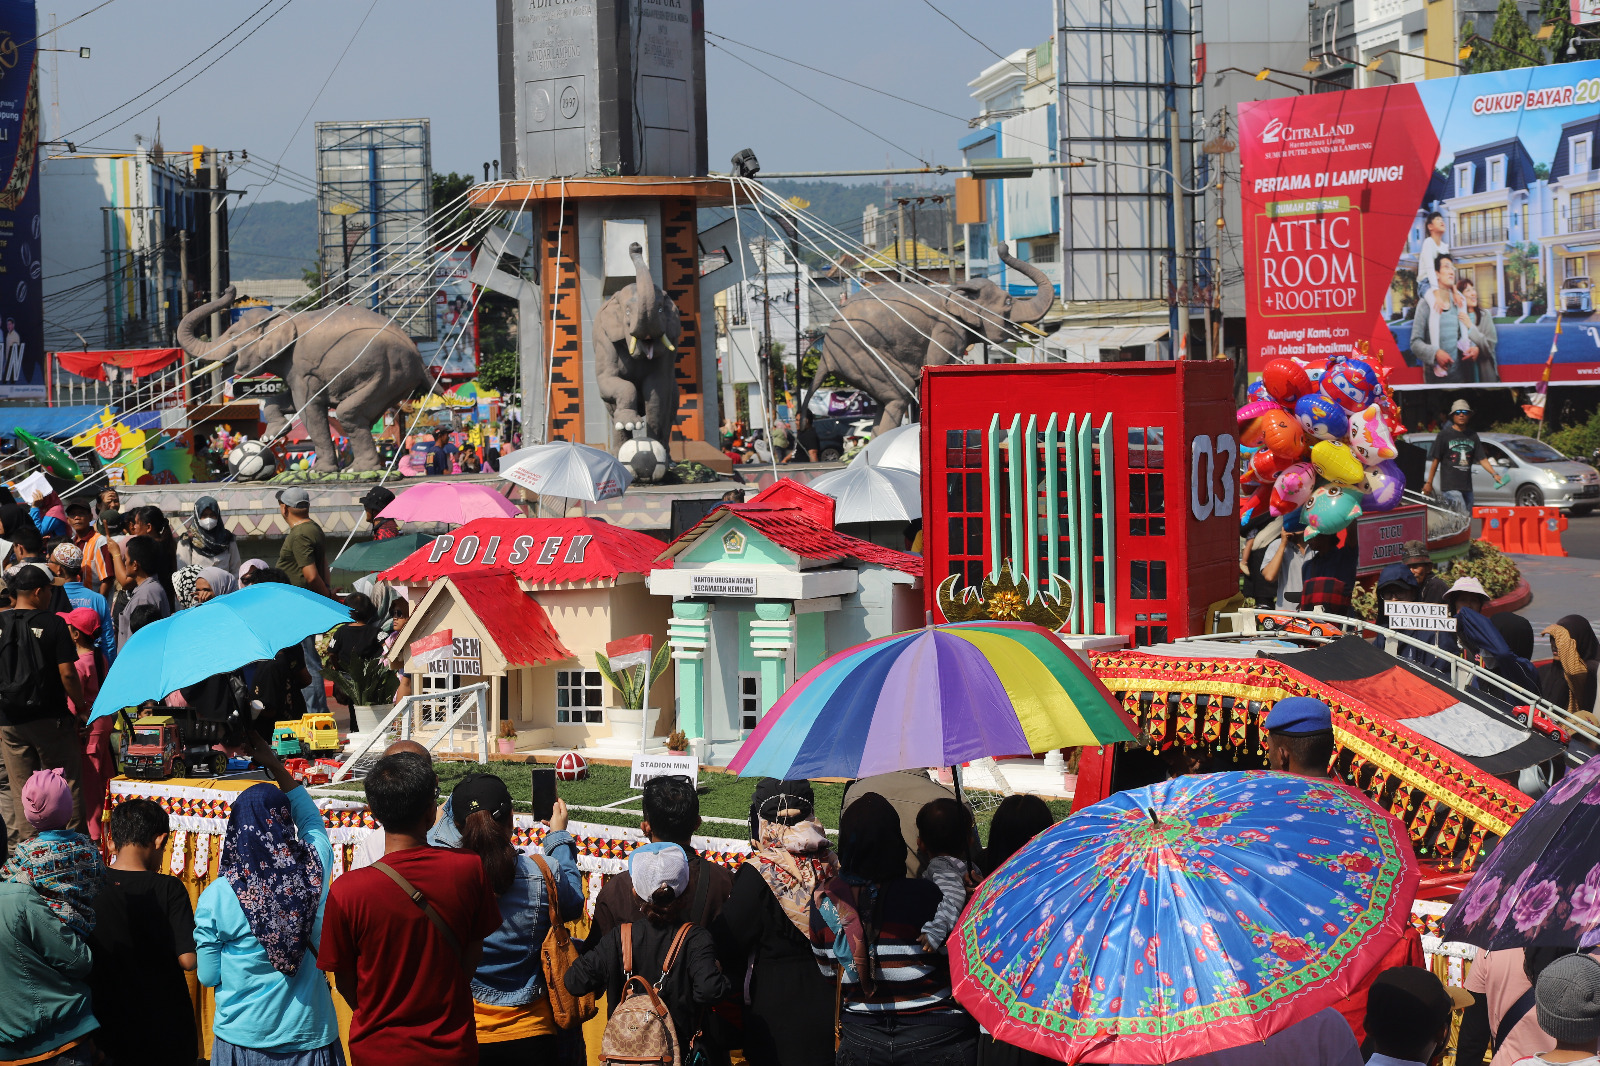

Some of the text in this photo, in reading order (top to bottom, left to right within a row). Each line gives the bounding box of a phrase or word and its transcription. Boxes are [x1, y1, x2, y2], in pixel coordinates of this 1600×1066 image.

[1474, 93, 1523, 113] CUKUP
[1526, 88, 1572, 108] BAYAR
[1288, 149, 1308, 157] PUTRI
[1311, 145, 1339, 155] BANDAR
[1339, 142, 1373, 153] LAMPUNG
[1289, 140, 1325, 149] Harmonious
[1254, 165, 1403, 194] PERTAMA DI LAMPUNG!
[1275, 202, 1304, 214] RUMAH
[1263, 216, 1350, 254] ATTIC
[1262, 252, 1358, 288] ROOM
[1265, 288, 1357, 311] +ROOFTOP
[1268, 327, 1349, 341] Kunjungi Kami, dan
[1260, 346, 1276, 357] pilih
[1278, 344, 1305, 355] Lokasi
[101, 435, 115, 450] 03
[1191, 433, 1237, 521] 03
[1380, 525, 1403, 540] TUGU
[428, 534, 592, 565] POLSEK
[1372, 544, 1404, 559] ADIPUR
[694, 584, 754, 593] KECAMATAN KEMILING
[736, 577, 754, 585] AGAMA
[1386, 603, 1446, 616] FLYOVER
[1390, 616, 1456, 630] KEMILING
[452, 637, 479, 657] SEK
[640, 761, 672, 769] STADION
